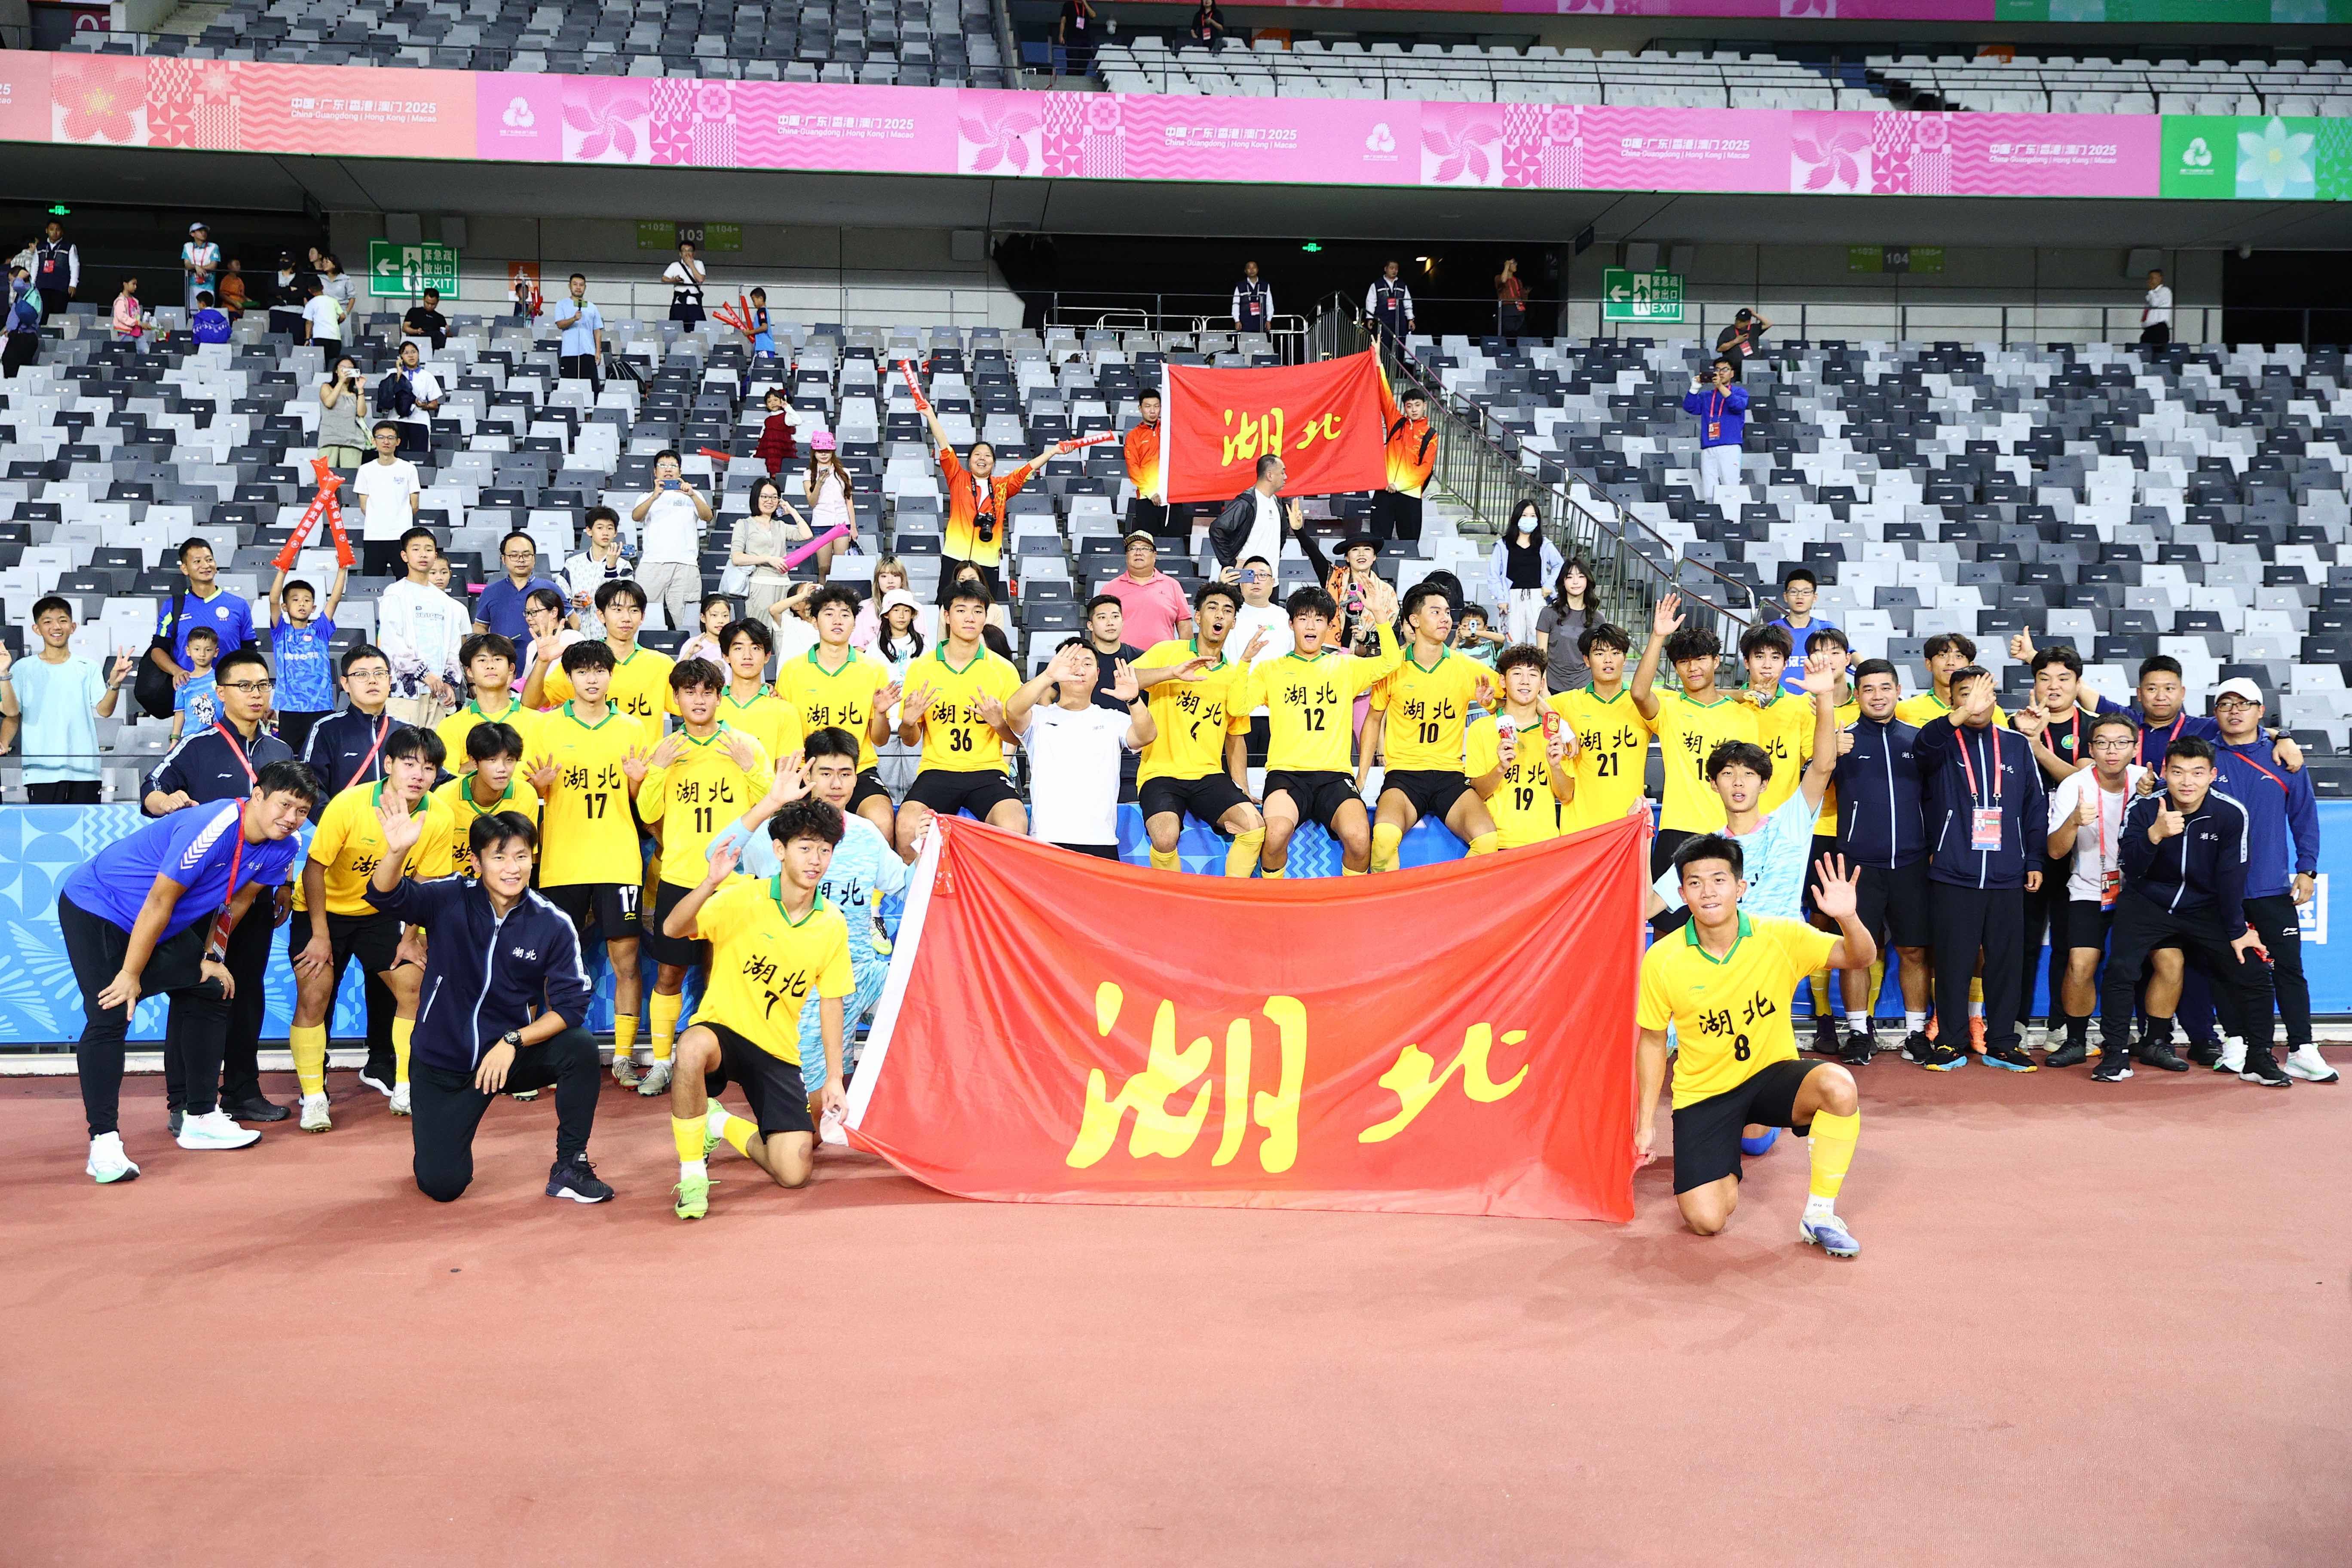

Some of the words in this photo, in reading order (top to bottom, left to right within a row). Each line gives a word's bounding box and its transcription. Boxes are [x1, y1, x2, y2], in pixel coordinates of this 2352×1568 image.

[364, 113, 384, 122] Hong
[387, 114, 405, 123] Kong
[405, 102, 436, 113] 2025
[846, 129, 865, 138] Hong
[867, 130, 885, 139] Kong
[885, 118, 914, 129] 2025
[1268, 129, 1297, 140] 2025
[1231, 141, 1250, 149] Hong
[1721, 140, 1750, 150] 2025
[2089, 145, 2116, 156] 2025
[679, 229, 704, 241] 103
[423, 263, 452, 275] 散出口
[1886, 253, 1909, 264] 104
[424, 278, 452, 289] EXIT
[1652, 303, 1677, 313] EXIT
[1222, 407, 1341, 467] 湖北
[329, 494, 344, 530] 北必胜
[1284, 681, 1337, 706] 湖北
[807, 701, 863, 726] 湖北
[1176, 690, 1222, 726] 湖北
[1304, 707, 1325, 731] 12
[1403, 697, 1455, 720] 湖北
[950, 728, 972, 752] 36
[1419, 722, 1439, 744] 10
[1579, 724, 1638, 752] 湖北
[1765, 735, 1787, 760] 北
[564, 763, 620, 790] 湖北
[1596, 752, 1618, 777] 21
[677, 777, 734, 804] 湖北
[1514, 787, 1533, 810] 19
[585, 793, 607, 819] 17
[695, 807, 712, 833] 11
[2199, 832, 2219, 841] 湖北
[452, 841, 472, 863] 湖
[619, 885, 638, 913] 17
[512, 946, 537, 961] 湖北
[743, 954, 806, 998] 湖北
[764, 990, 779, 1020] 7
[1699, 990, 1776, 1037] 湖北
[1734, 1034, 1751, 1062] 8
[1066, 981, 1529, 1173] 湖北
